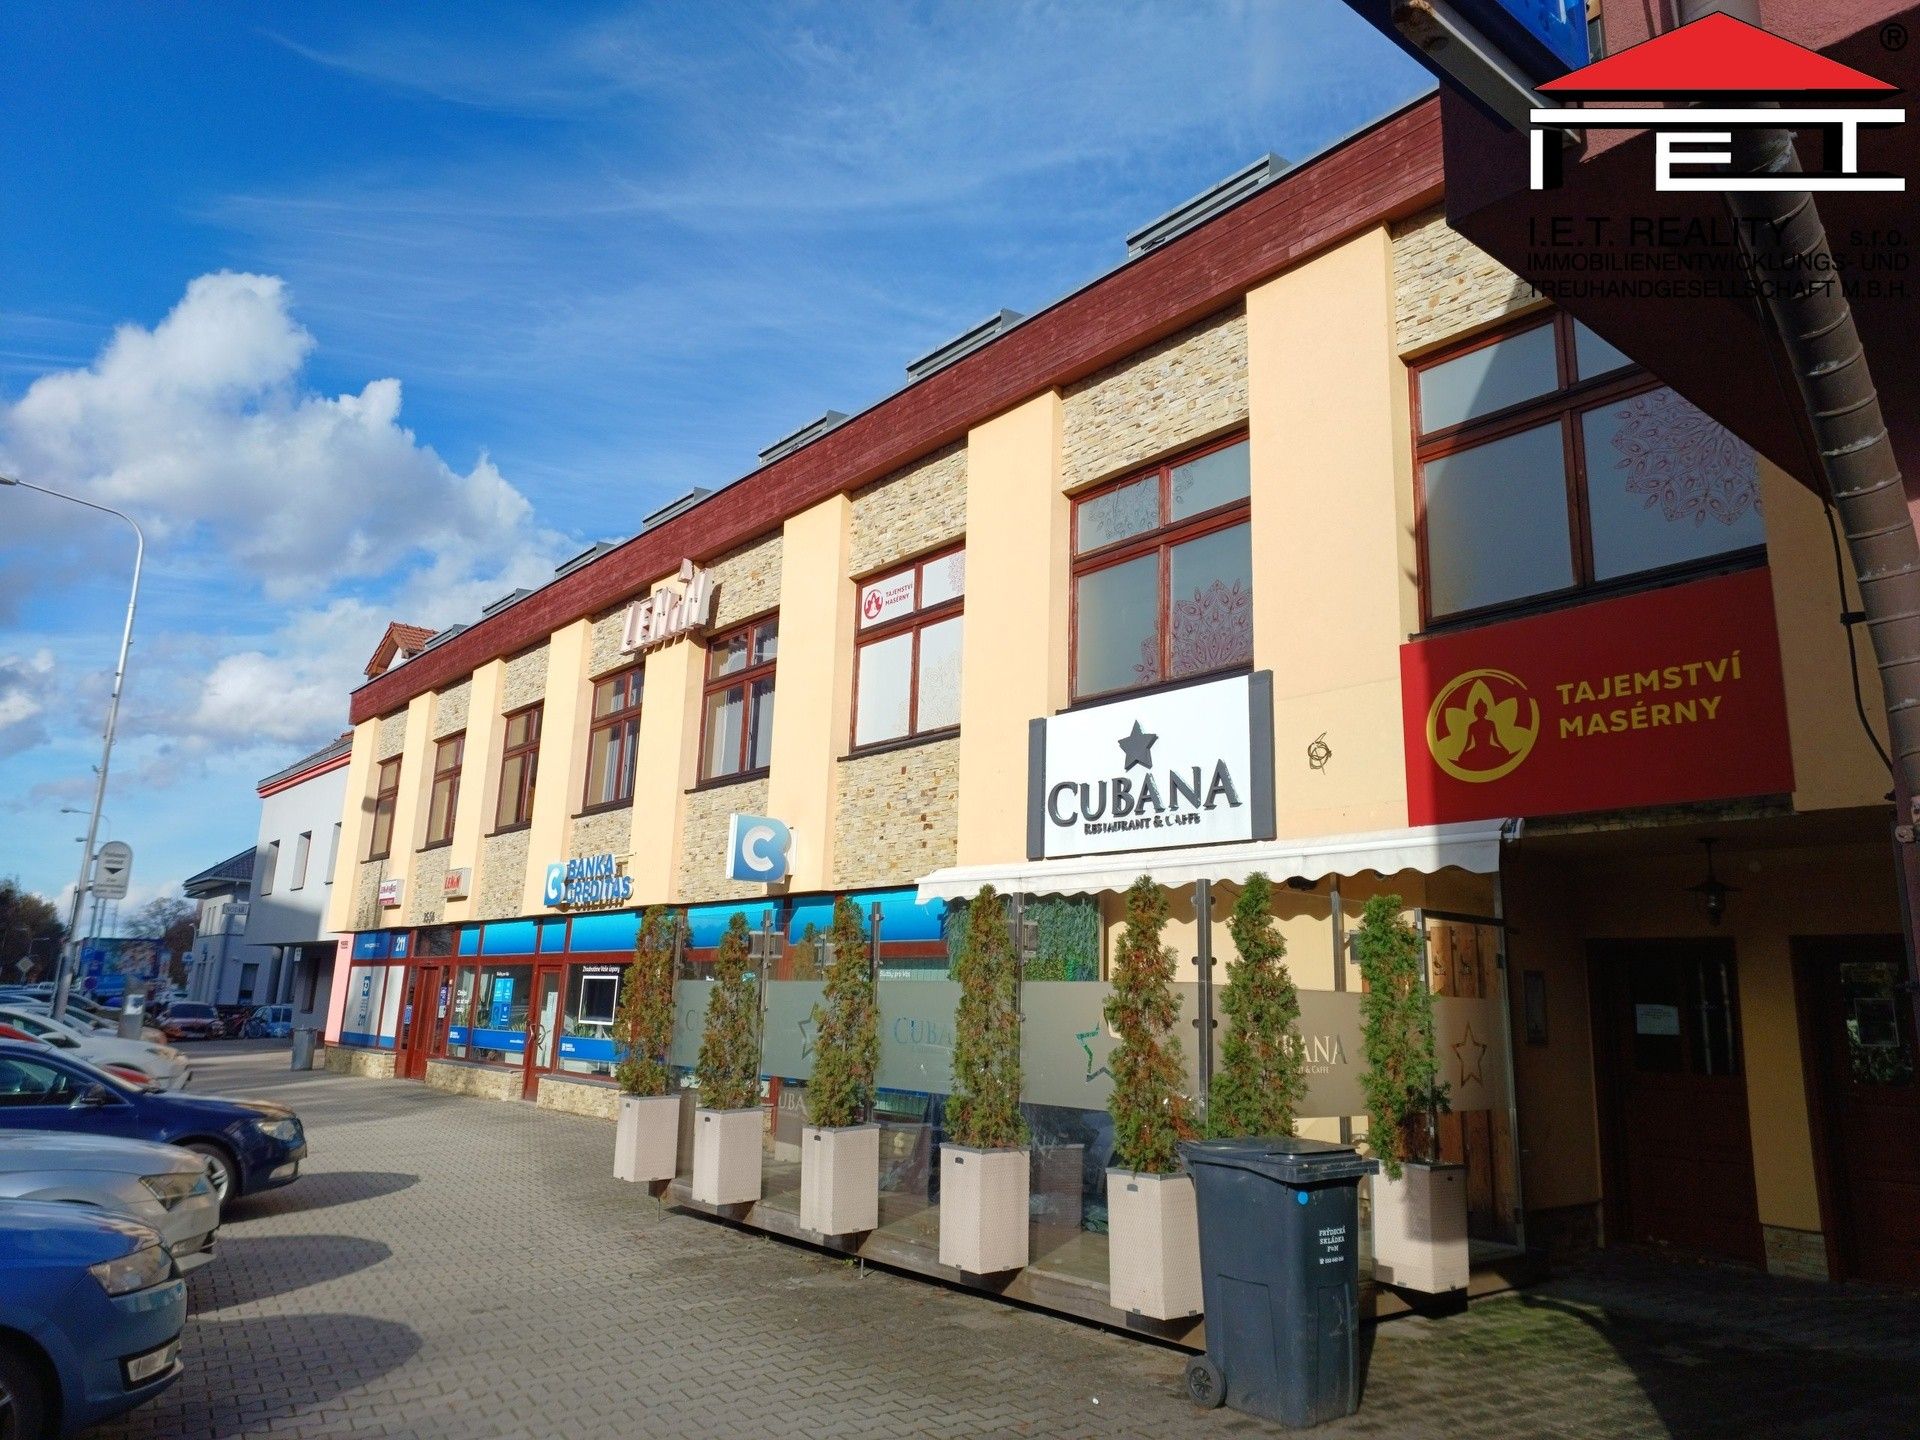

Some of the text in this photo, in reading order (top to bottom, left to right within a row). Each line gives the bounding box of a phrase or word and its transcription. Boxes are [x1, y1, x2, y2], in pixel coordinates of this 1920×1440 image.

[1556, 650, 1741, 705] TAJEMSTVÍ
[1559, 696, 1721, 739] MASÉRNY
[1047, 758, 1243, 827] CUBANA
[1083, 817, 1151, 835] RESTAURANT
[1152, 816, 1164, 828] &
[568, 853, 614, 880] BANKA
[566, 875, 633, 905] CREDITAS
